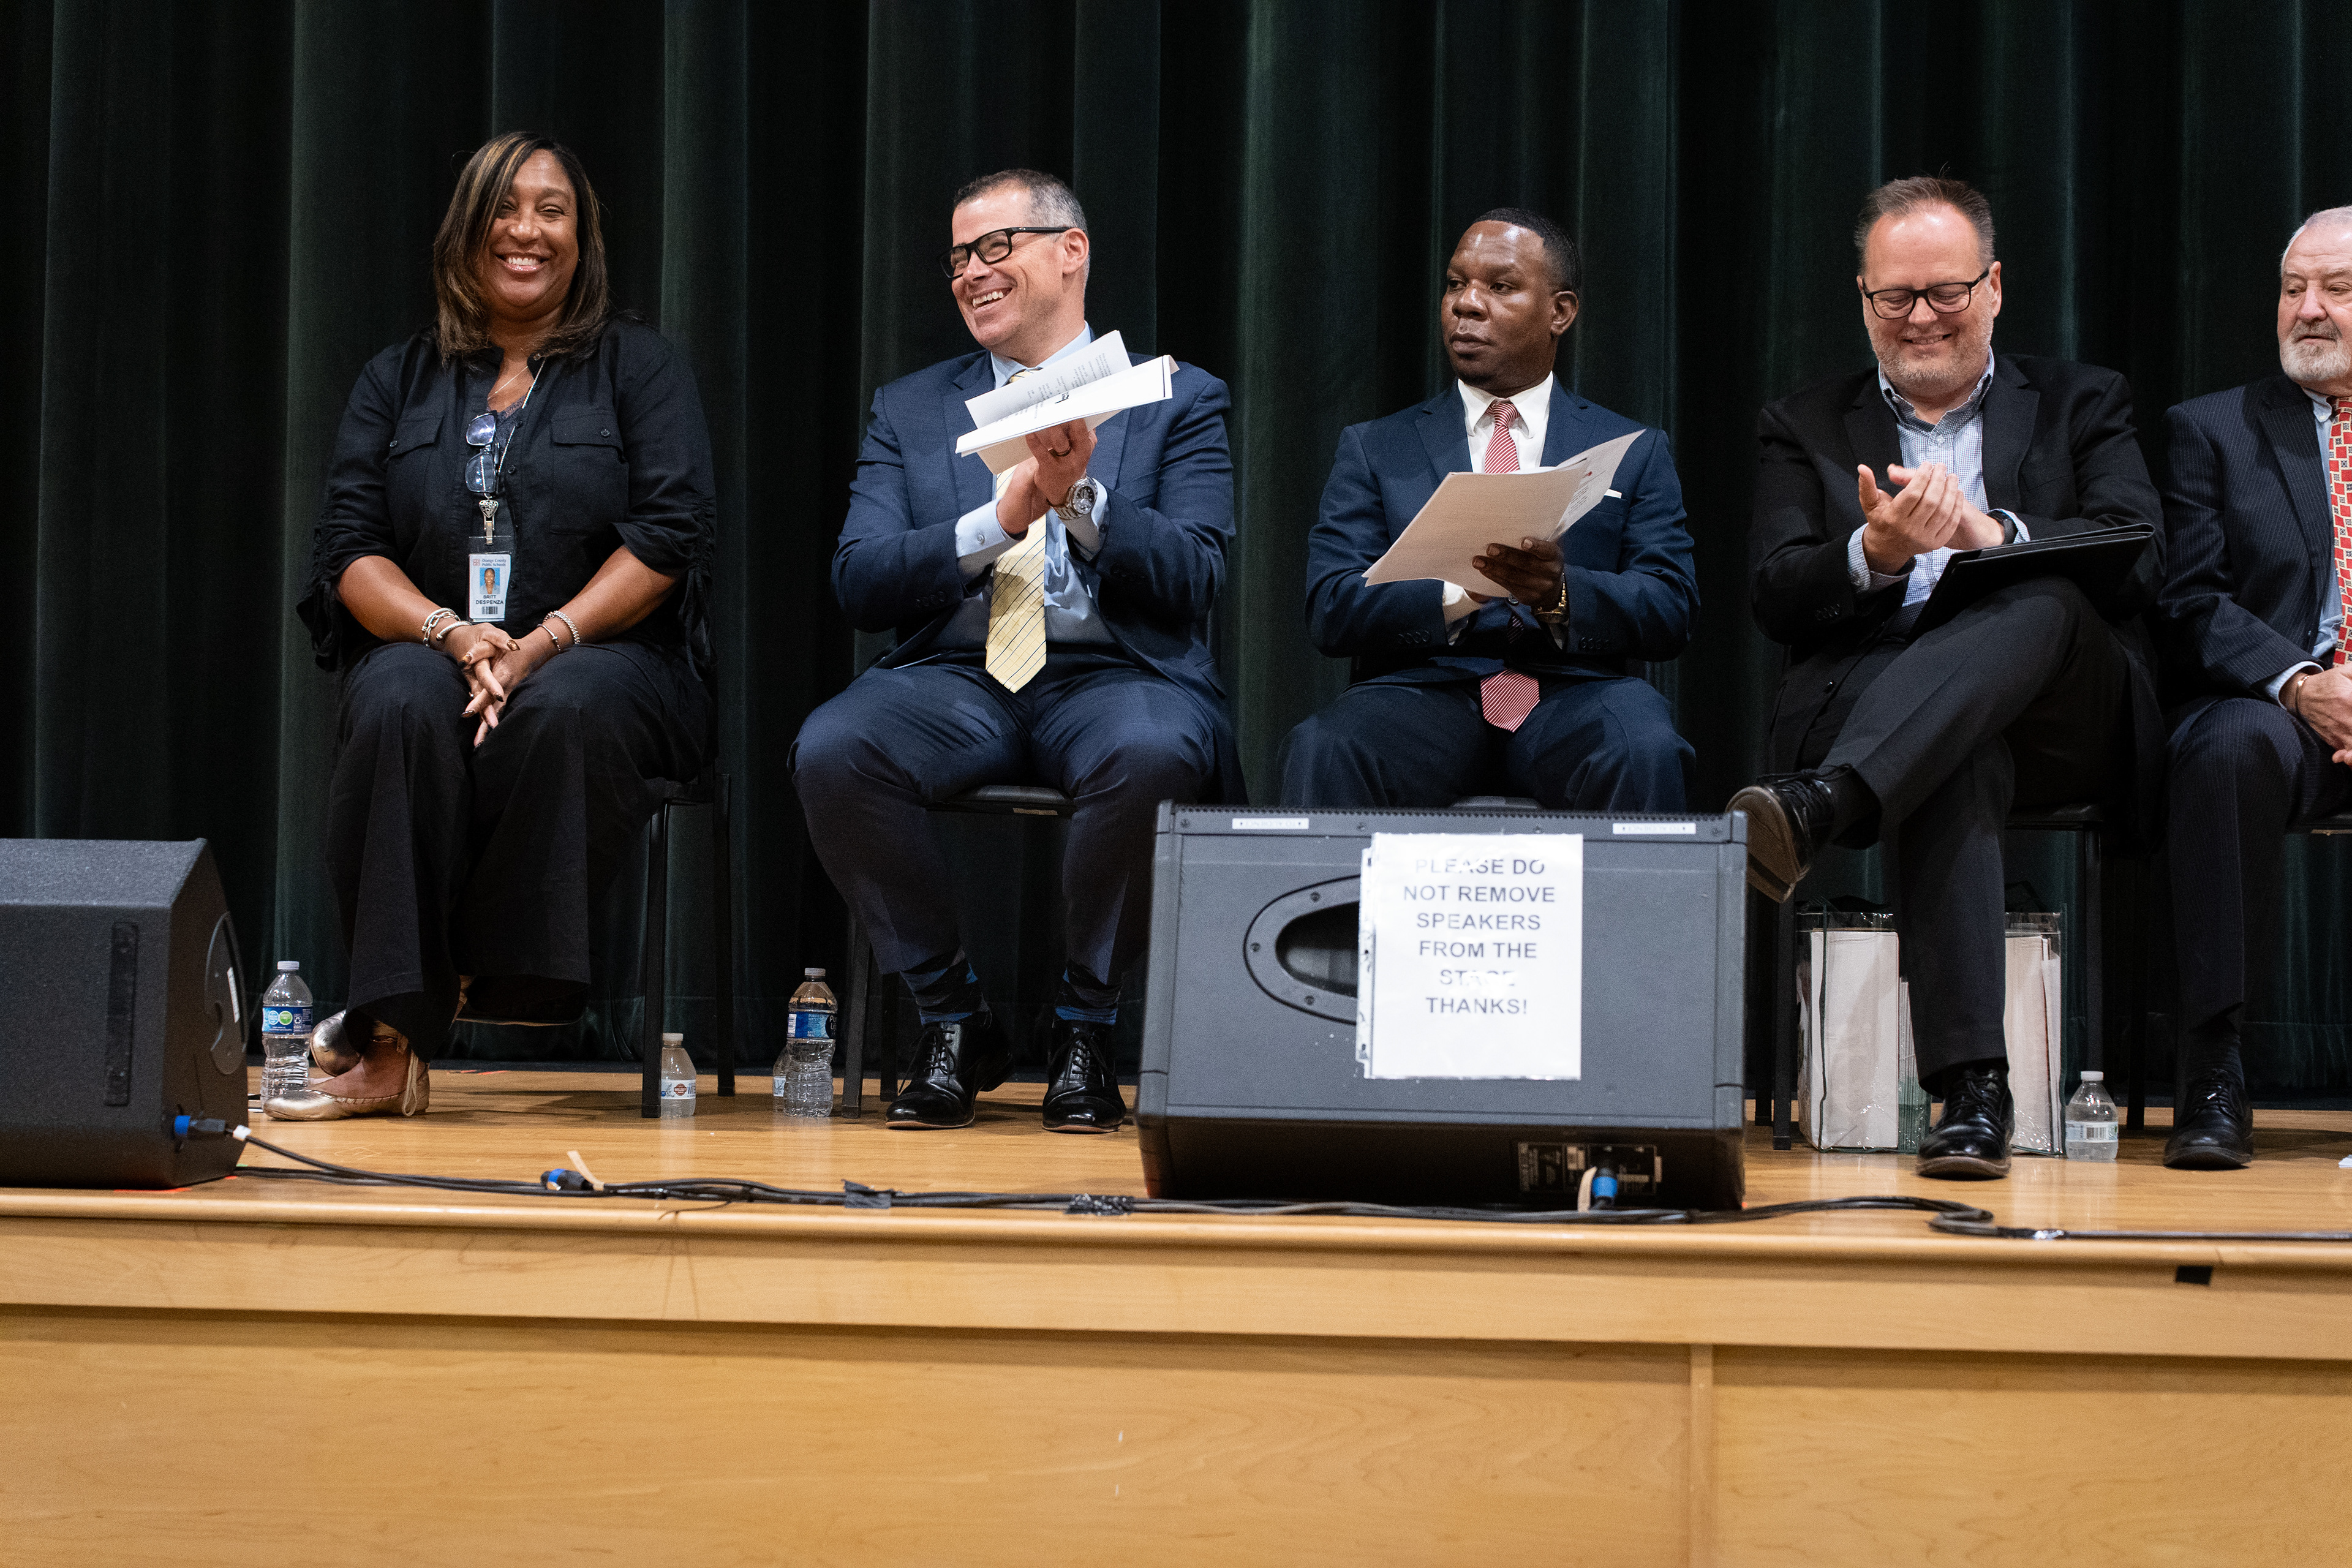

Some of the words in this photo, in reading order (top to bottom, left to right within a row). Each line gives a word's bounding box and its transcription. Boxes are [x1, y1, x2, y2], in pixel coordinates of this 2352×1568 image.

[1513, 859, 1545, 875] DO
[1404, 885, 1450, 900] NOT
[1458, 886, 1555, 902] REMOVE
[1417, 913, 1540, 930] SPEAKERS
[1419, 940, 1484, 957] FROM
[1493, 943, 1537, 959] THE
[1440, 969, 1515, 986] STA
[1426, 997, 1527, 1014] THANKS!
